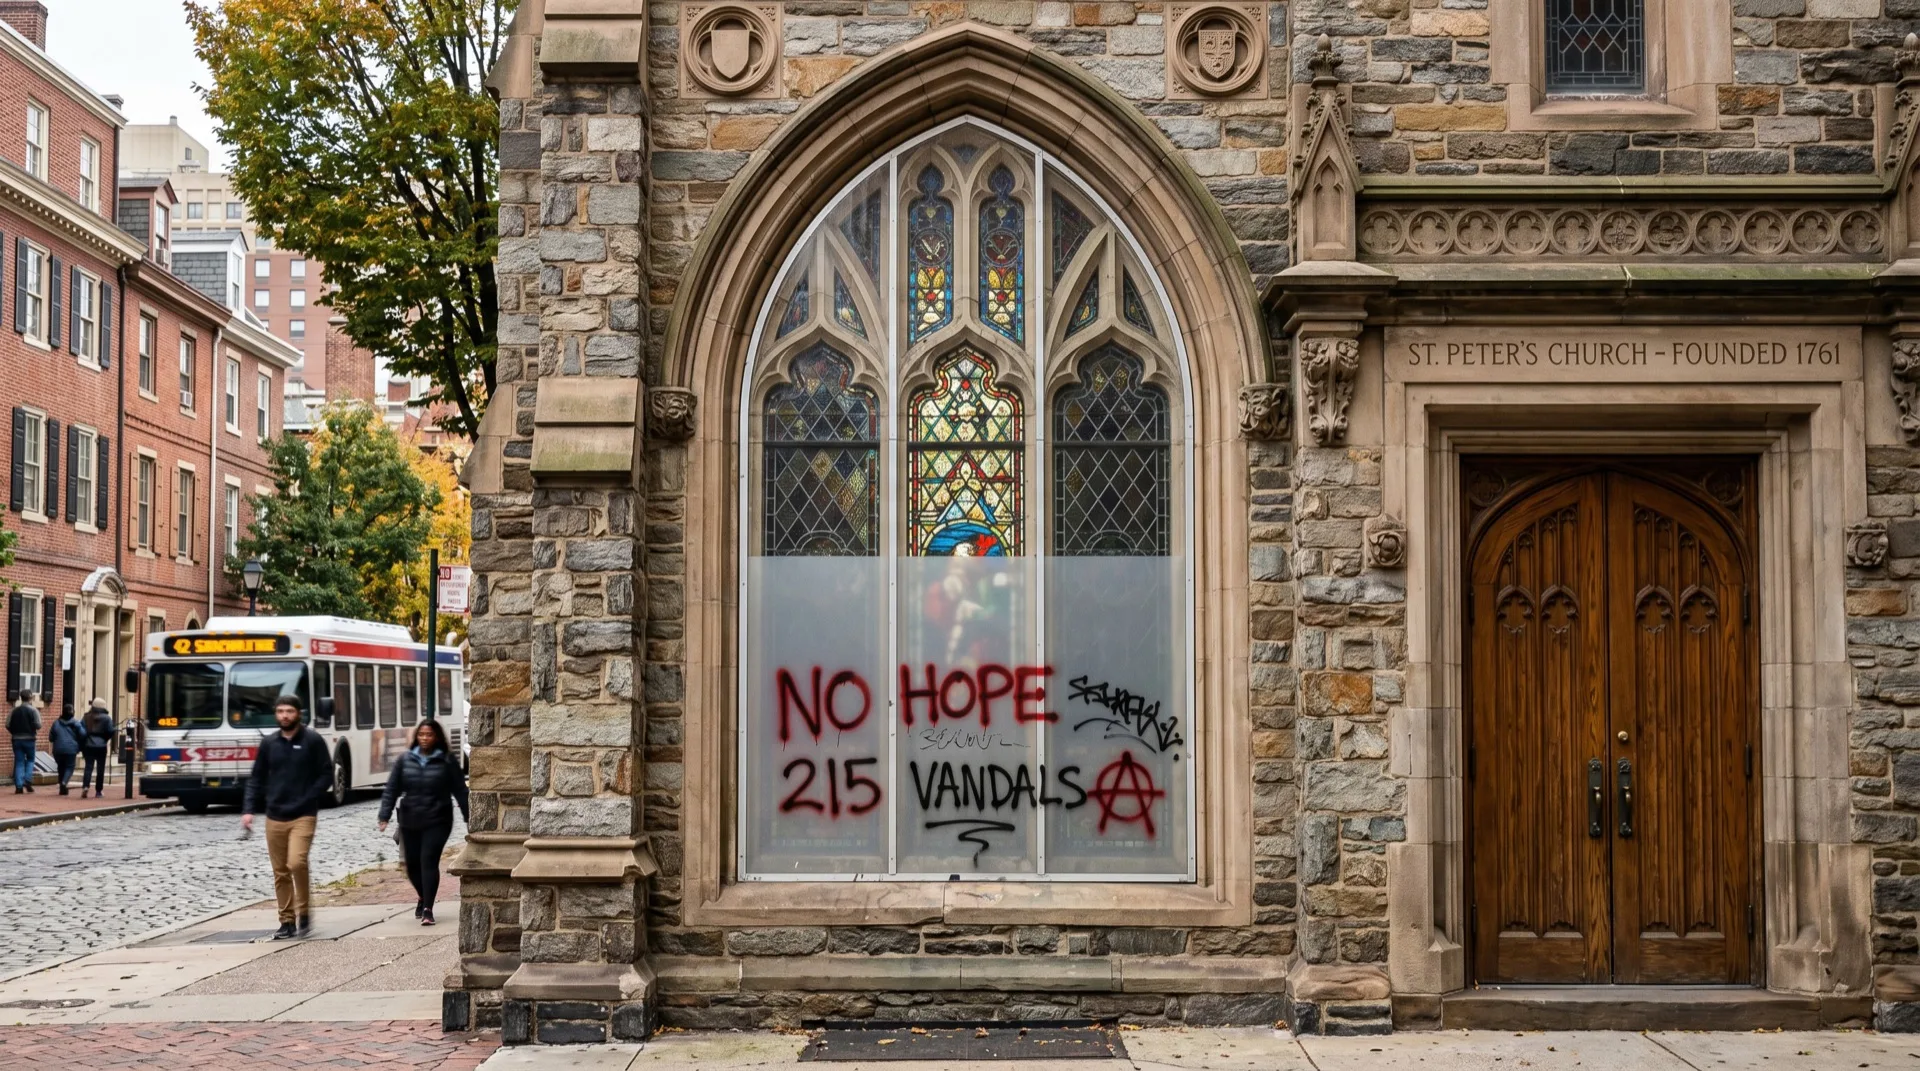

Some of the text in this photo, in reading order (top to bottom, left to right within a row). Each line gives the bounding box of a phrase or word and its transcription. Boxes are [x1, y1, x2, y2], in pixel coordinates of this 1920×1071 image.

[1408, 342, 1439, 366] ST.
[1446, 340, 1538, 366] PETER'S
[1548, 342, 1647, 366] CHURCH
[1672, 342, 1787, 366] FOUNDED
[1796, 341, 1840, 365] 1761
[776, 665, 871, 744] NO
[900, 663, 1059, 730] HOPE
[205, 749, 250, 760] SEPTA
[779, 757, 1087, 820] 215 VANDALS
